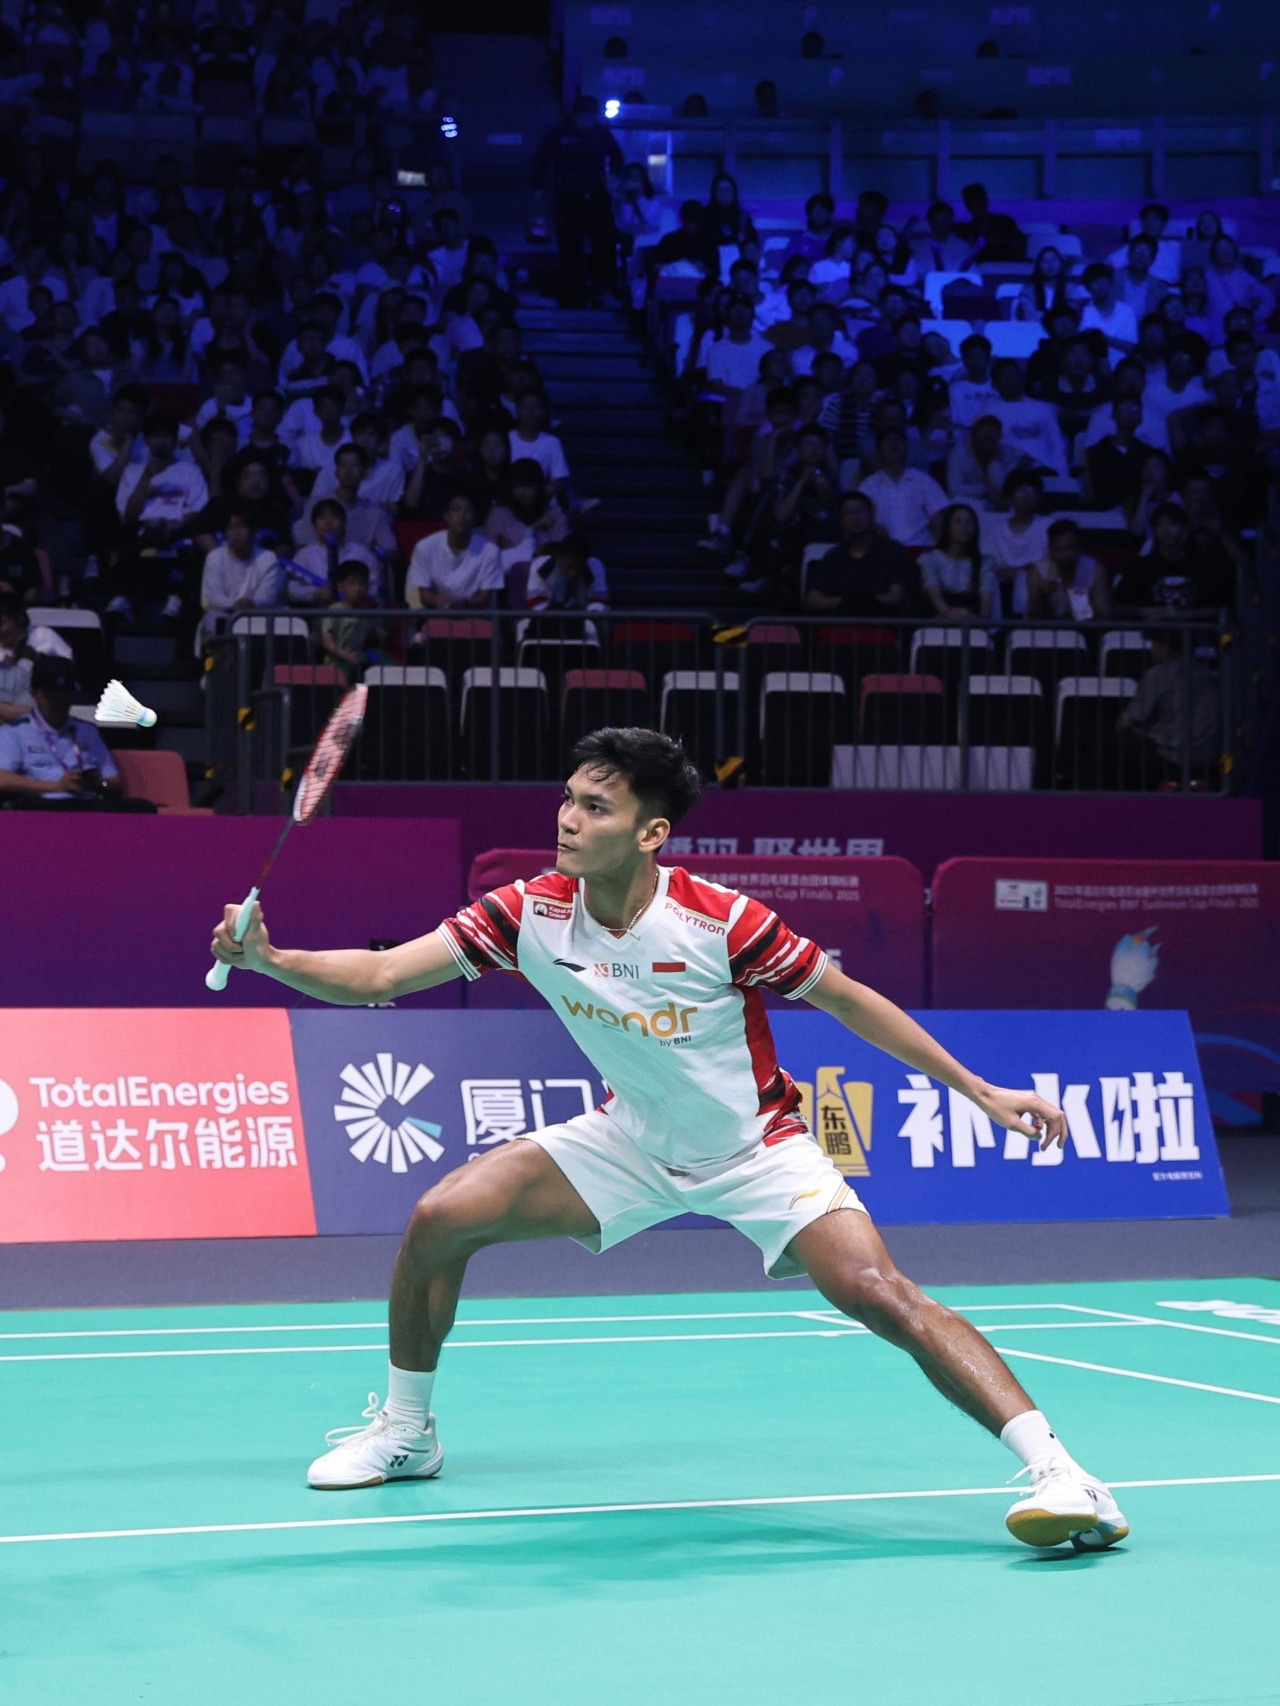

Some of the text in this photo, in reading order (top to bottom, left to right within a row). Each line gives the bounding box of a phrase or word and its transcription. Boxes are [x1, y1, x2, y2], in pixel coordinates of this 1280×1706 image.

[664, 901, 726, 936] POLYTRON
[612, 963, 639, 979] BNI
[561, 995, 698, 1037] wondr
[674, 1035, 692, 1045] BNI
[29, 1073, 290, 1114] TotalEnergies
[461, 1078, 609, 1145] 厦门
[898, 1071, 1200, 1167] 补水啦
[36, 1116, 298, 1172] 道达尔能源
